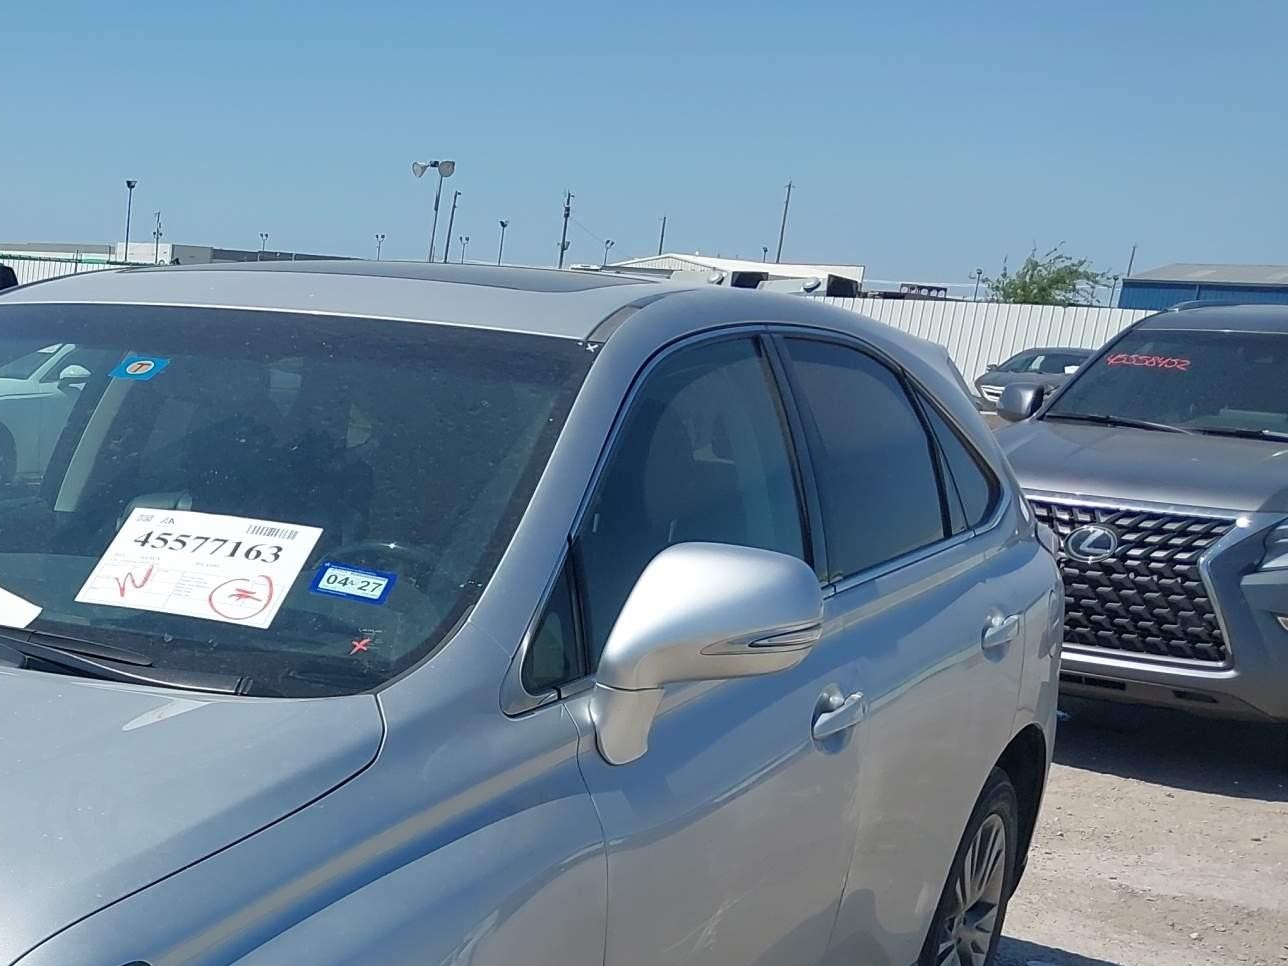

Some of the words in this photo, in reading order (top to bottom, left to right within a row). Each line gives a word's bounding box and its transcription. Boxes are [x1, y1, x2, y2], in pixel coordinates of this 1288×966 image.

[134, 530, 283, 564] 45577163
[326, 574, 350, 587] 04
[357, 580, 383, 593] 27
